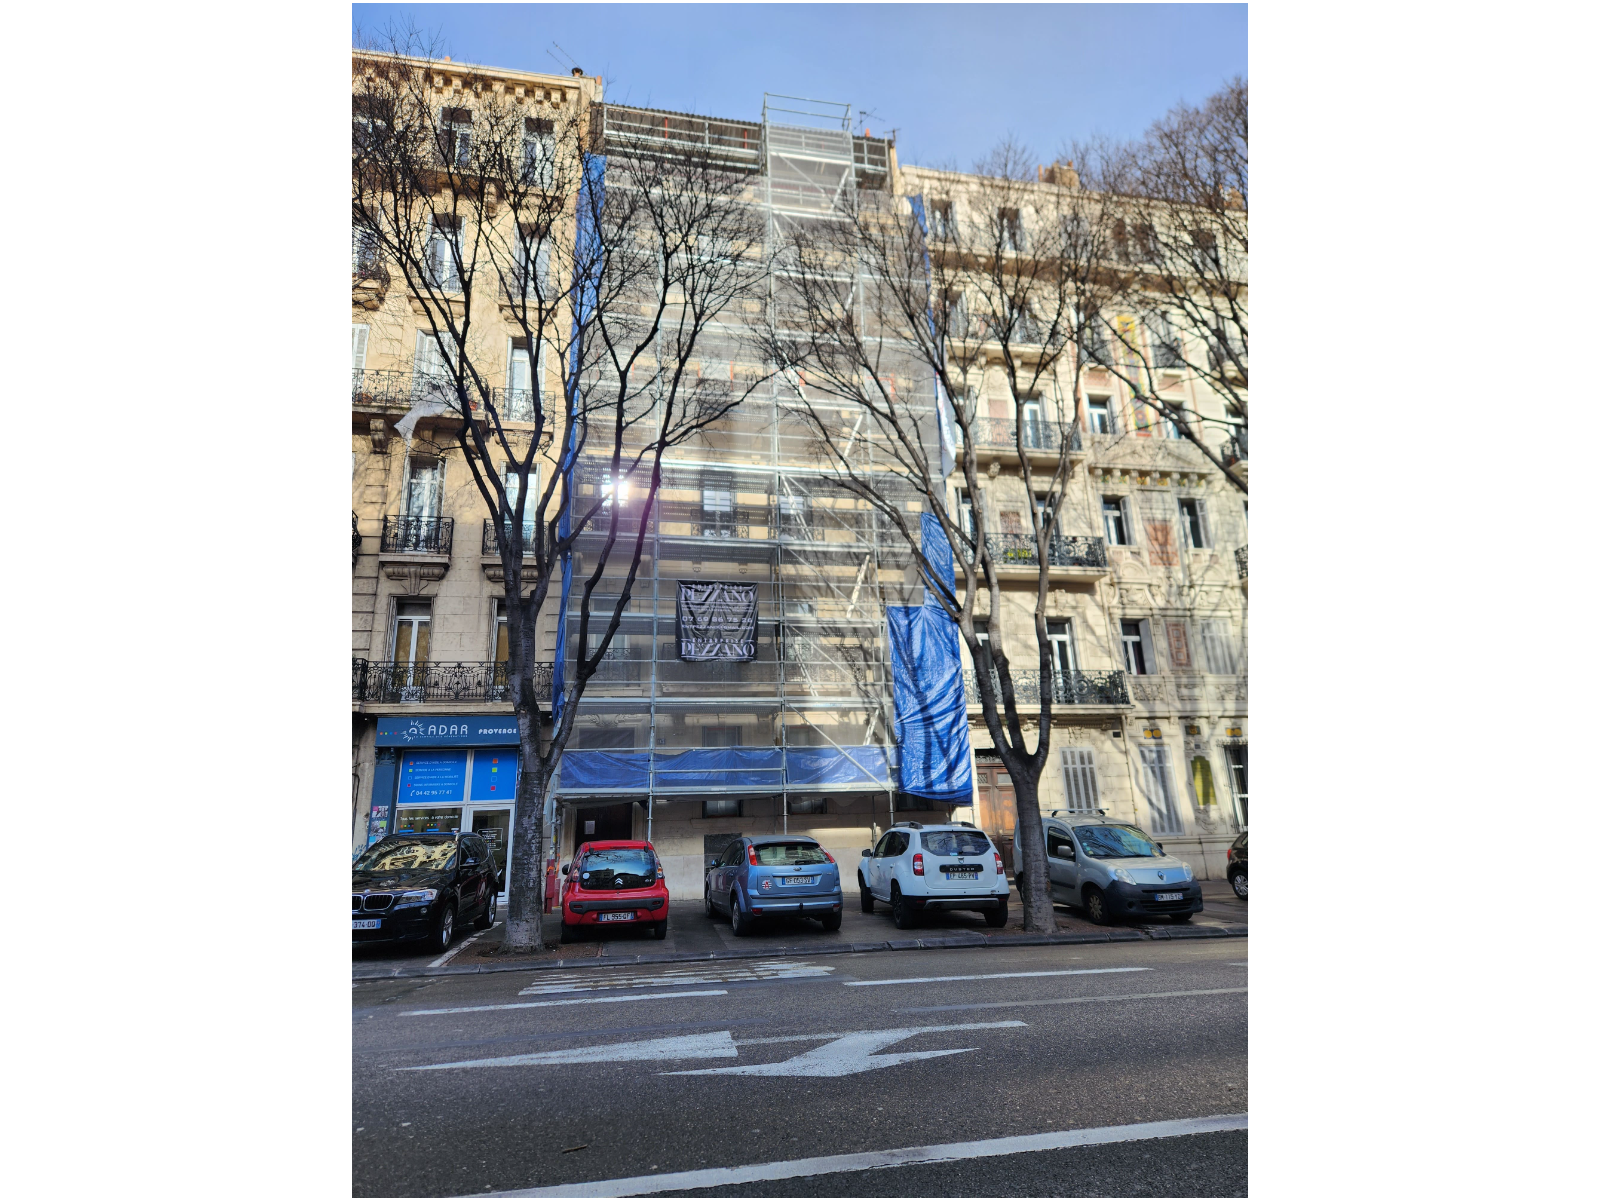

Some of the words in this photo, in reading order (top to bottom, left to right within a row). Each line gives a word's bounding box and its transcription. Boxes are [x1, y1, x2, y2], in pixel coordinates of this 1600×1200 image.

[681, 588, 754, 602] PEZZANO
[681, 642, 755, 657] PEZZANO
[428, 724, 469, 736] ADAR
